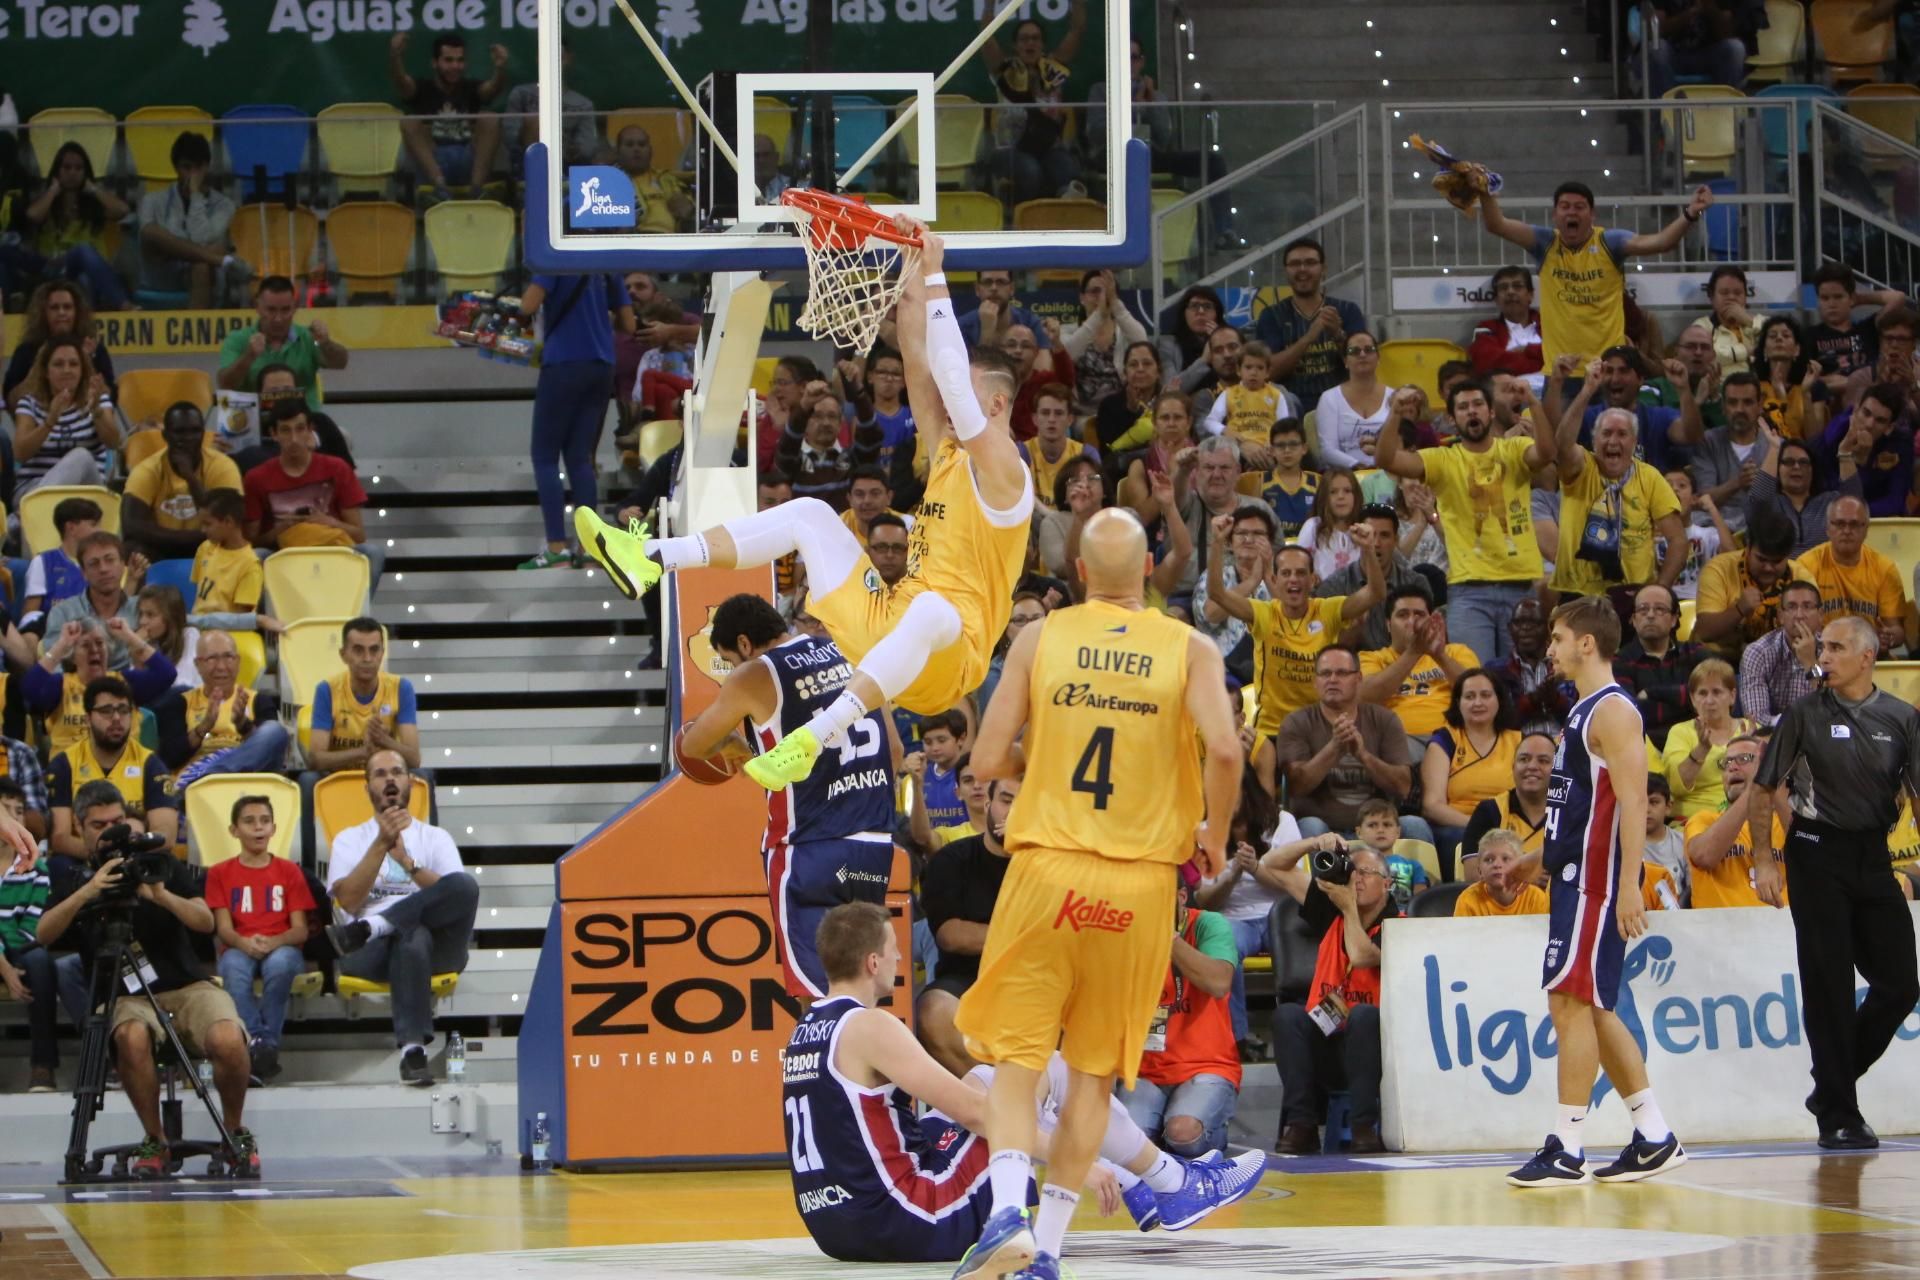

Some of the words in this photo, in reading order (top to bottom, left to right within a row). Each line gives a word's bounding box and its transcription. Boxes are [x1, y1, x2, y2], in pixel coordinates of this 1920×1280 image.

[16, 0, 140, 38] Teror
[267, 0, 414, 42] Aguas
[741, 0, 887, 33] Agas
[591, 203, 630, 215] endesa
[1552, 267, 1605, 282] HERBALIFE
[165, 316, 253, 346] CANAR
[784, 641, 844, 670] CHAGOYE
[1077, 646, 1153, 678] OLIVER
[1271, 645, 1317, 662] HERBALI
[1086, 693, 1158, 716] AirEuropa
[1071, 726, 1115, 811] 4
[1052, 889, 1135, 934] Kalise
[572, 1054, 600, 1068] TU
[619, 1050, 713, 1066] TIENDA
[731, 1049, 759, 1063] DE
[784, 1094, 825, 1173] 21
[799, 1184, 854, 1214] ABANCA
